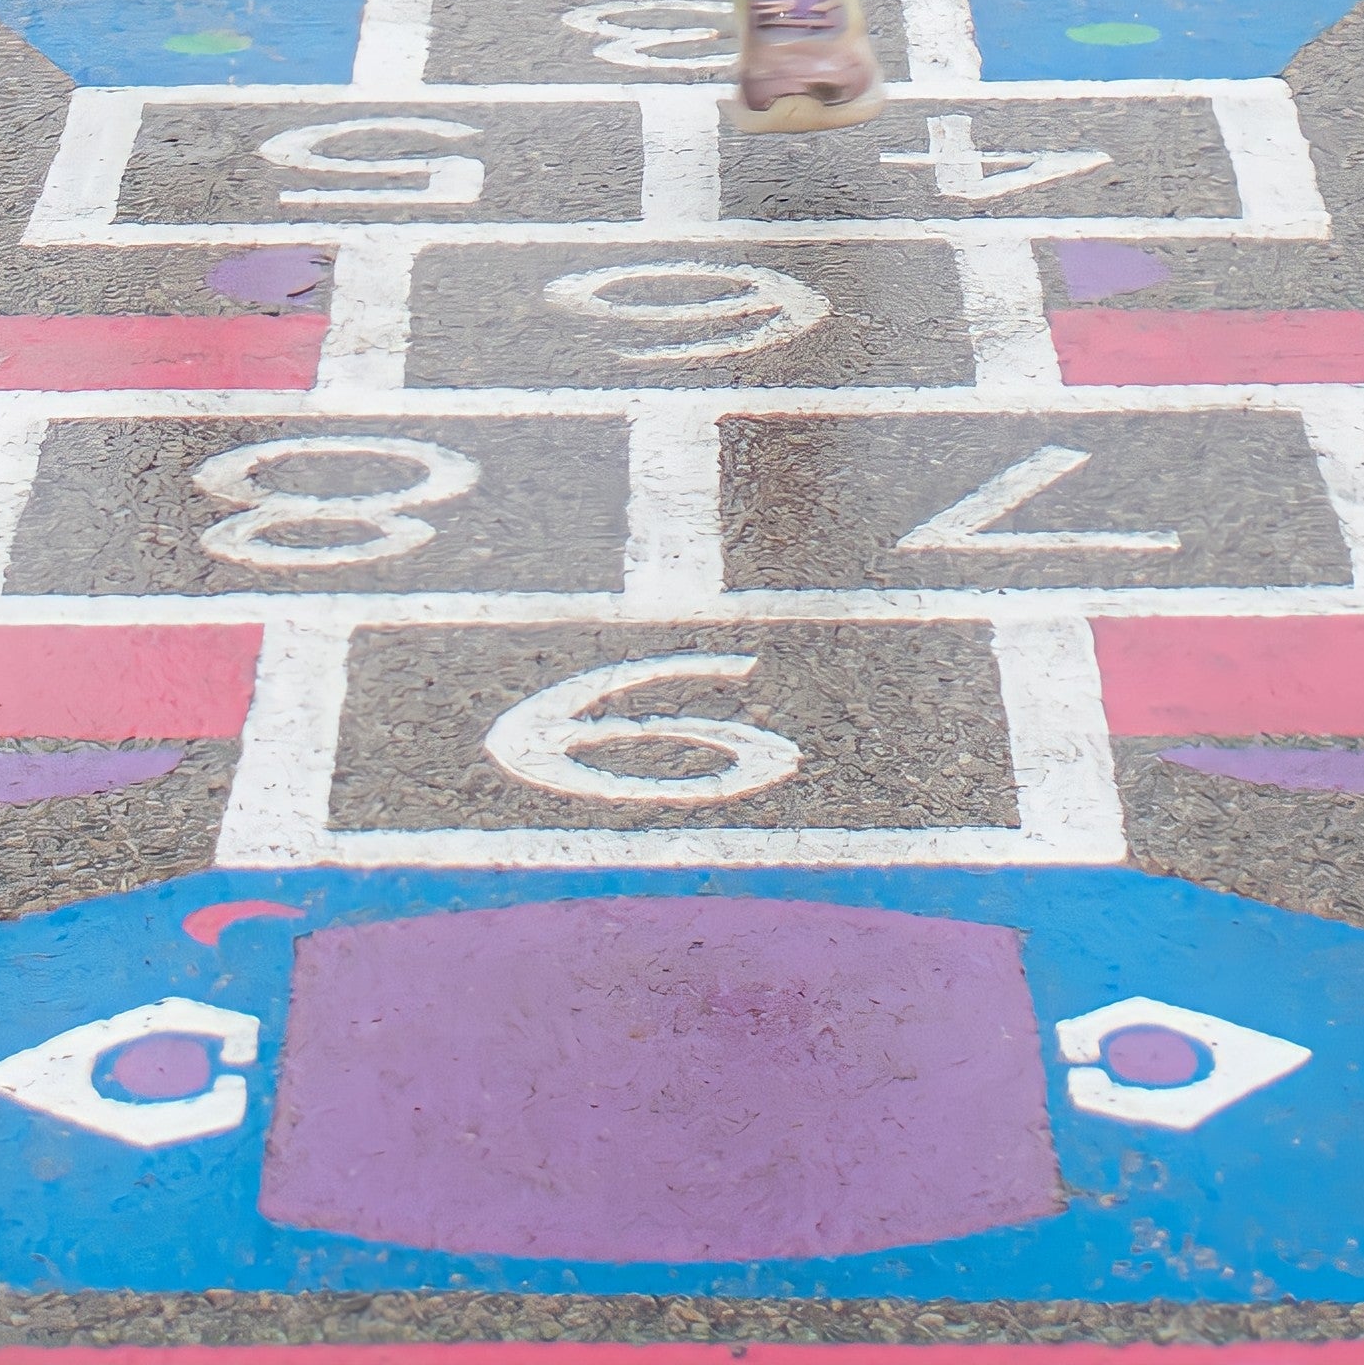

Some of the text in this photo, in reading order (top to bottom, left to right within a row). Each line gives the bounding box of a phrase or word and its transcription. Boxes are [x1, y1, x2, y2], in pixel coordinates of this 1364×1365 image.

[559, 0, 742, 70] 3
[257, 116, 486, 205] 5
[879, 115, 1114, 202] 4
[542, 260, 832, 361] 6
[190, 434, 482, 568] 8
[894, 444, 1182, 552] 7
[484, 652, 803, 803] 9
